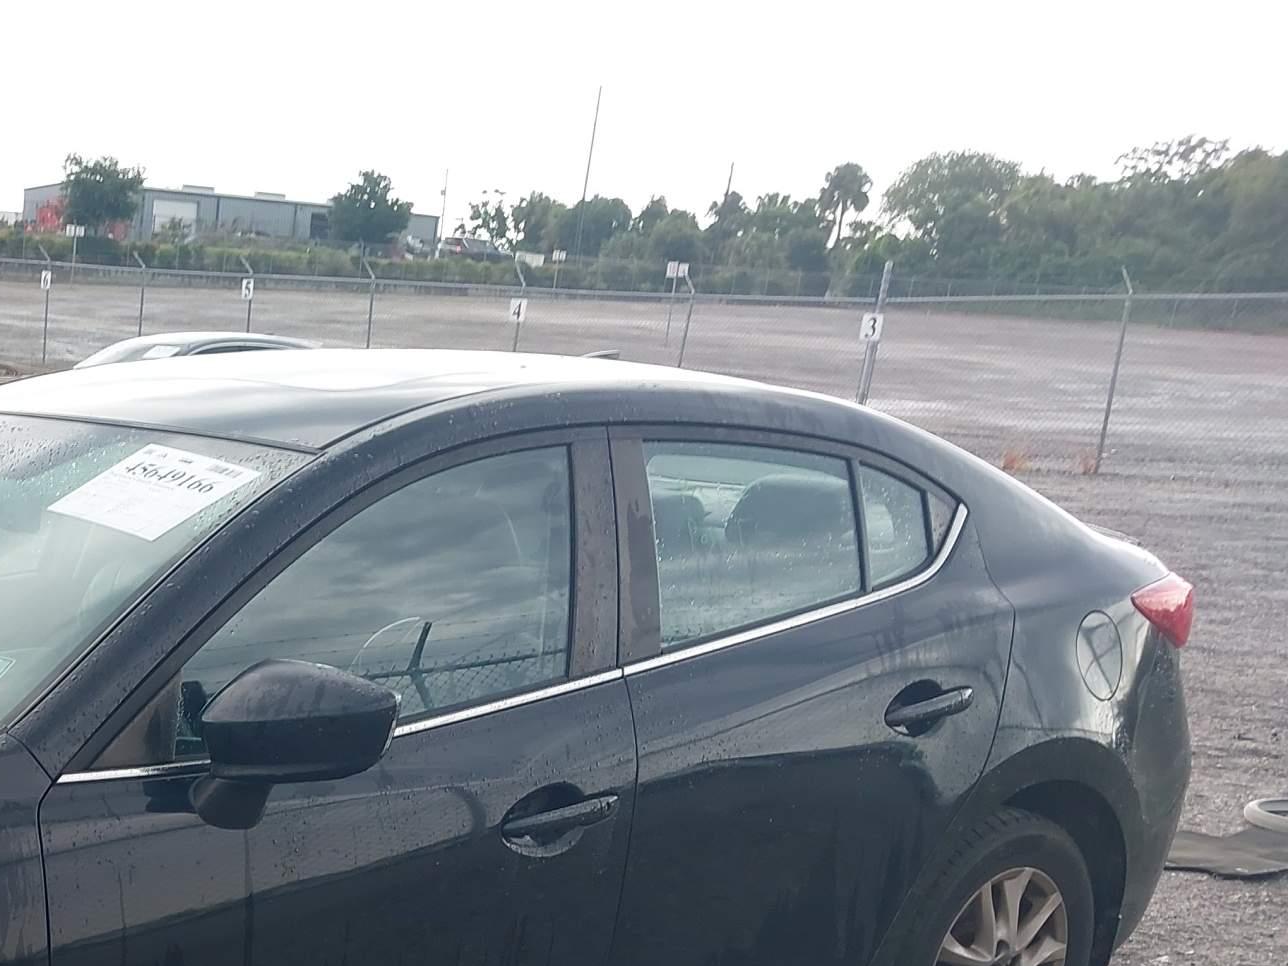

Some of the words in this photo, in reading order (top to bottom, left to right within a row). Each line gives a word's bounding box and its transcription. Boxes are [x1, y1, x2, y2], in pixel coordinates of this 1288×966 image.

[512, 301, 522, 320] 4
[864, 317, 877, 338] 3
[124, 461, 219, 494] 45649166
